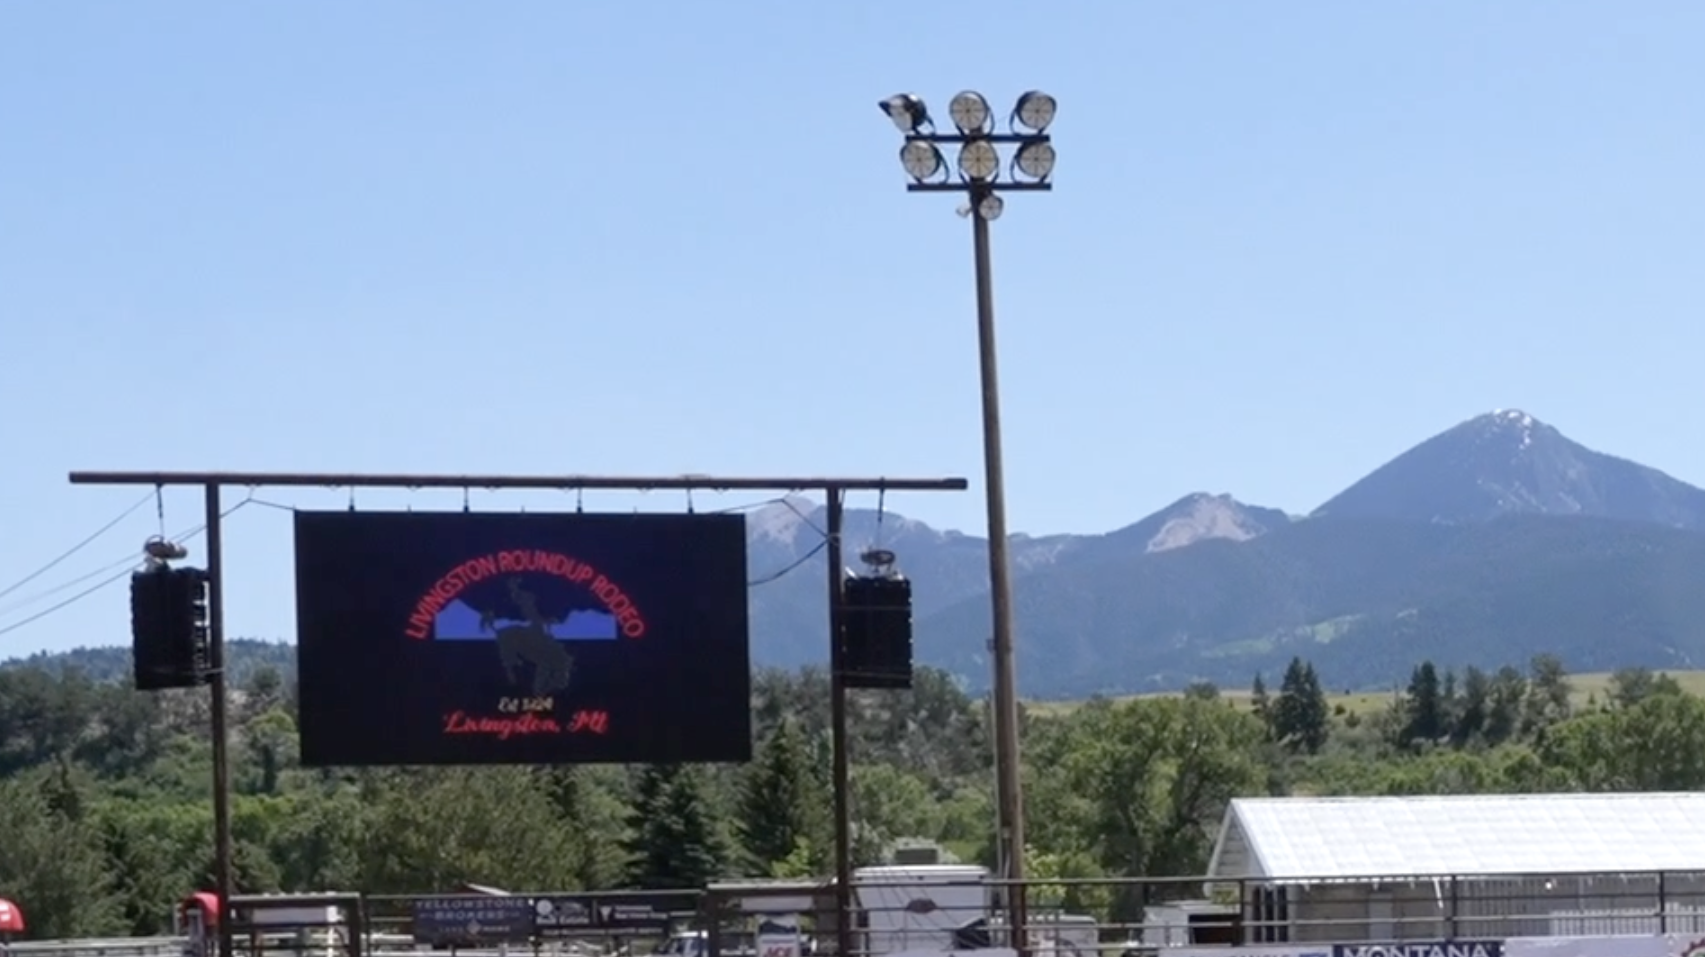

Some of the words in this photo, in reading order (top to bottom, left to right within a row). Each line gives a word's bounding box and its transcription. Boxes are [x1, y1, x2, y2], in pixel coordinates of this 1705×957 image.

[405, 554, 496, 640] LIVINGSTON
[498, 550, 594, 584] ROUNDUP
[589, 573, 645, 638] RODEO
